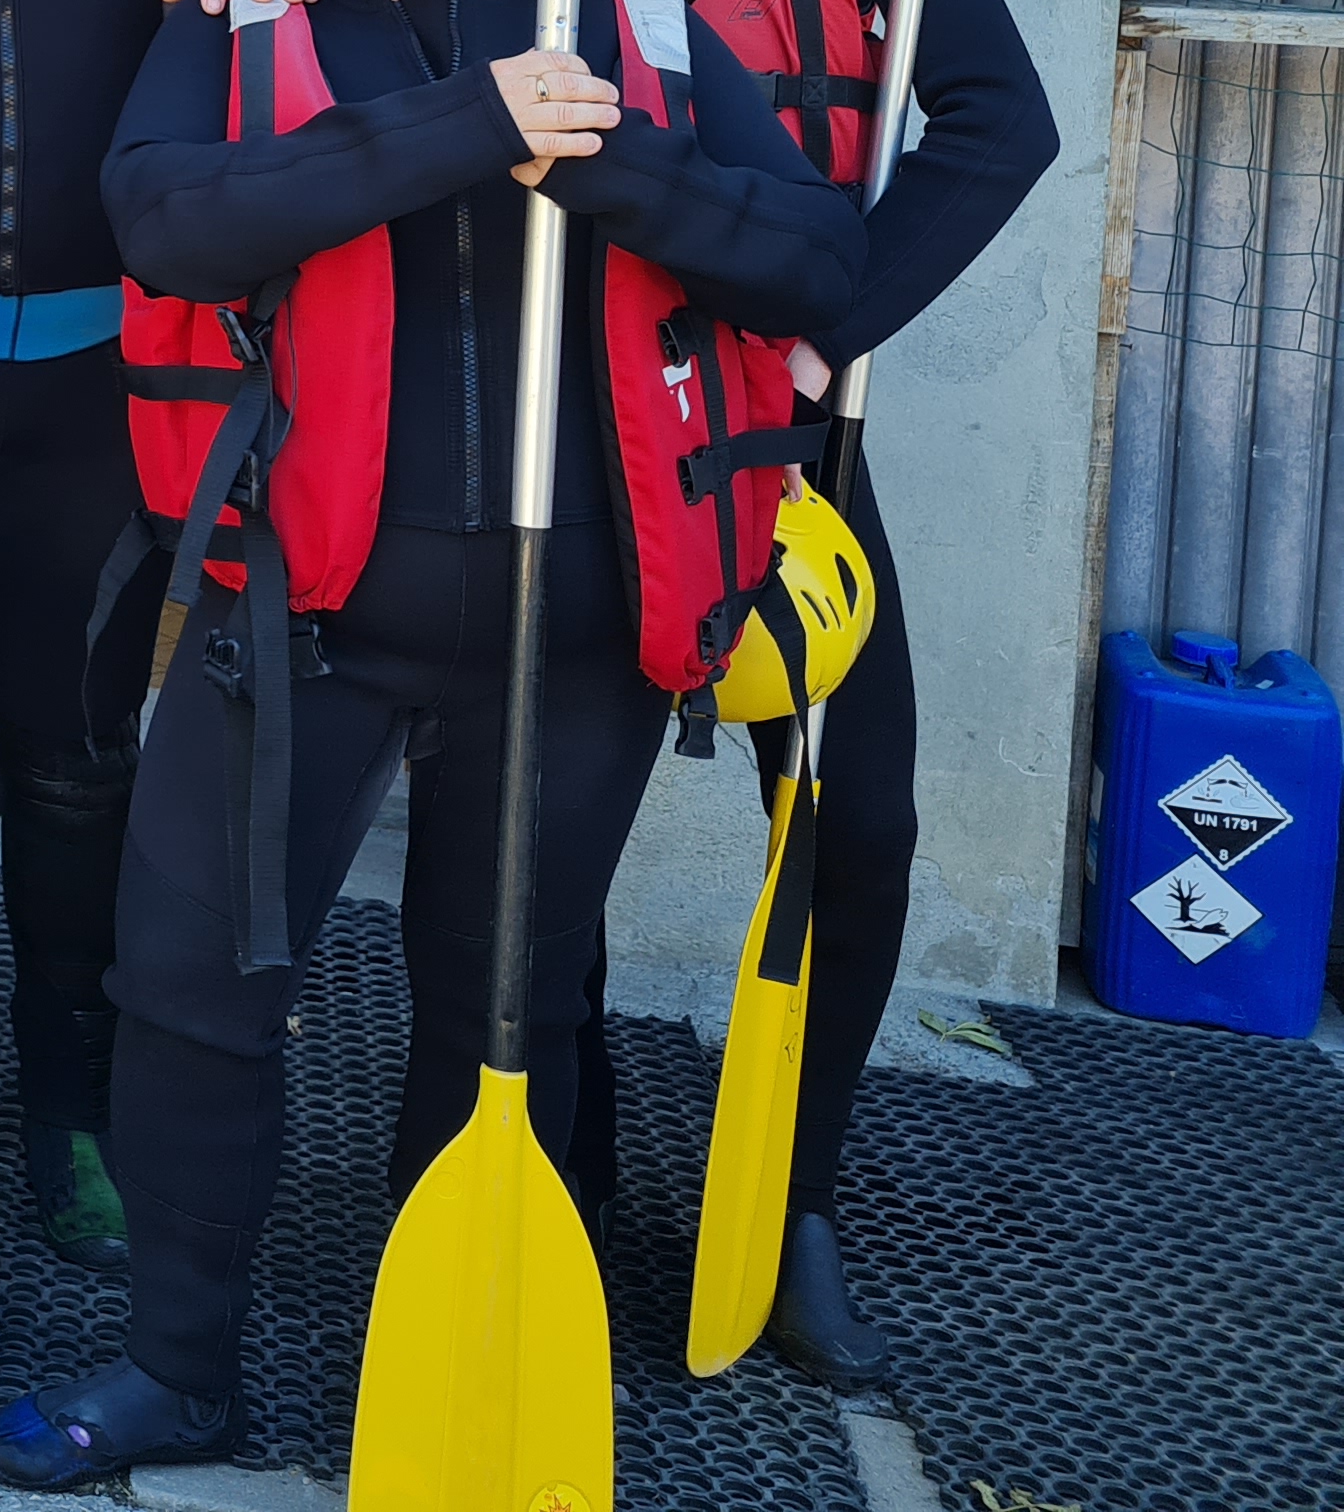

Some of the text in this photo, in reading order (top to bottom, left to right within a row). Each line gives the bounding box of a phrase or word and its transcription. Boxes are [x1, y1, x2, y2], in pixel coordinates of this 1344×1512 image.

[1193, 811, 1258, 832] UN 1791
[1218, 848, 1229, 861] 8
